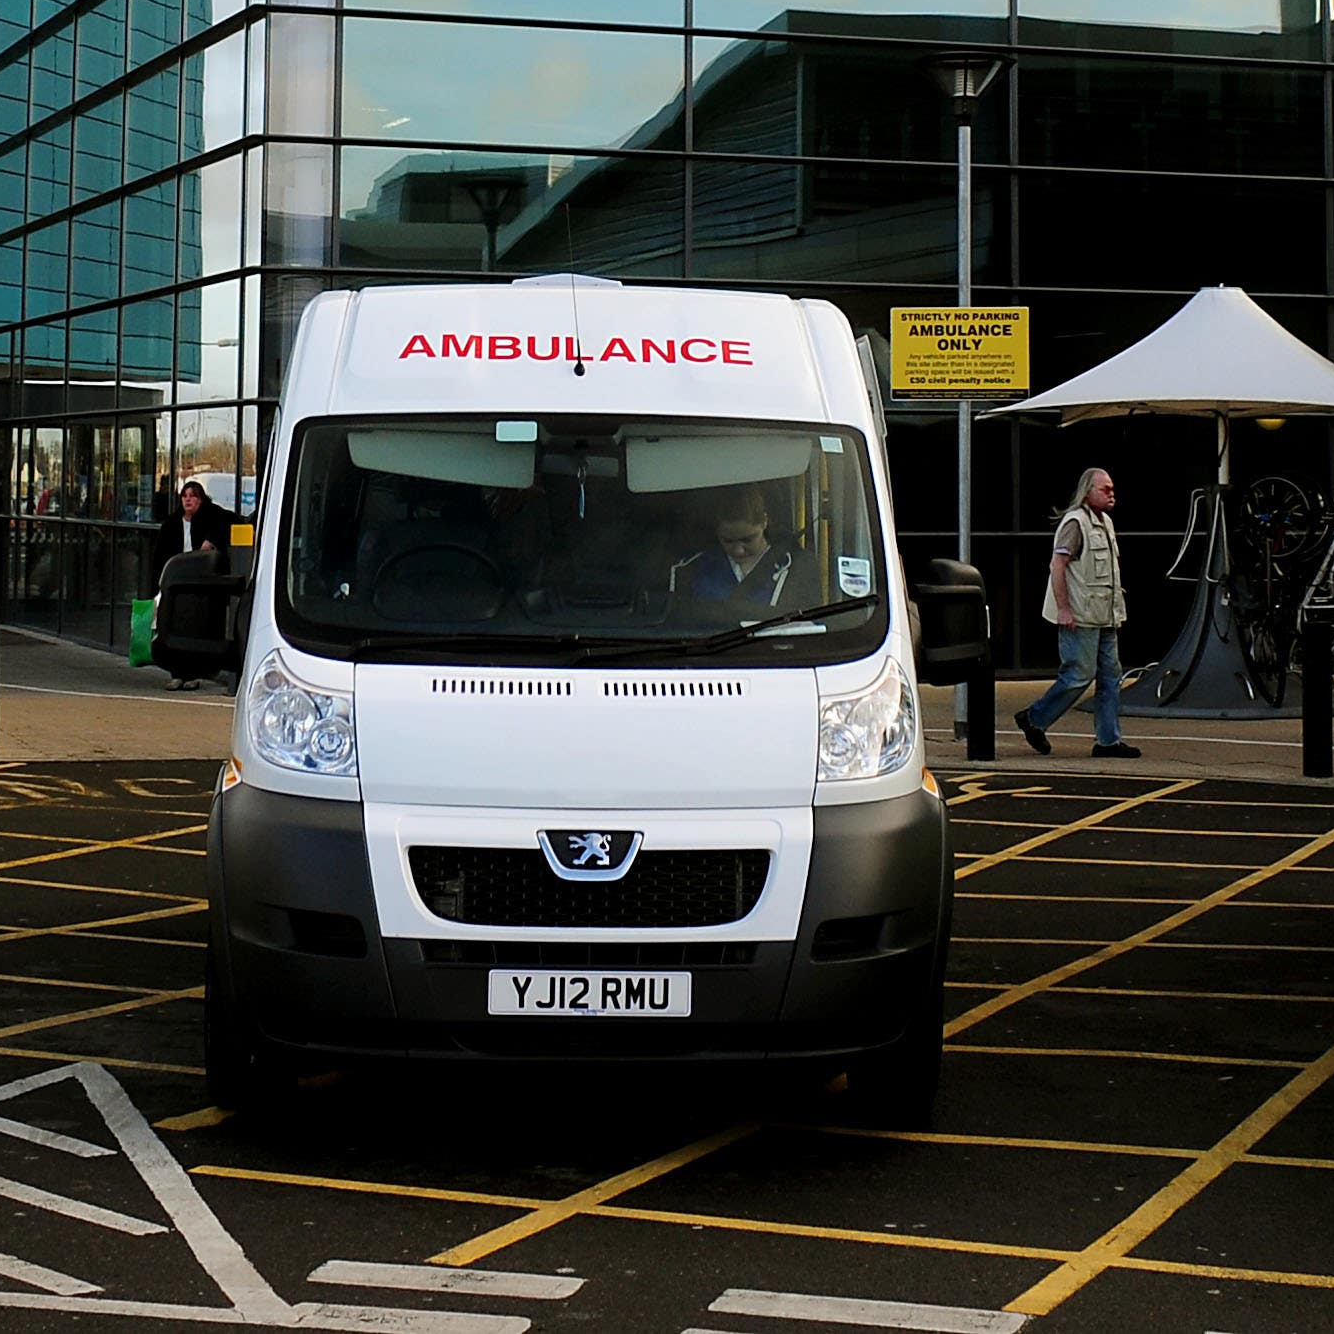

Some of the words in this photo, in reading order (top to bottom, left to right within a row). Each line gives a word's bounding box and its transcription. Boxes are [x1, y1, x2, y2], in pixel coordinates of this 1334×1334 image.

[901, 313, 951, 321] STRICTLY
[954, 313, 970, 321] NO
[909, 325, 1012, 336] AMBULANCE
[398, 334, 753, 366] AMBULANCE
[938, 339, 982, 350] ONLY
[948, 377, 980, 385] penalty
[512, 977, 589, 1009] YJ12
[601, 978, 670, 1010] RMU
